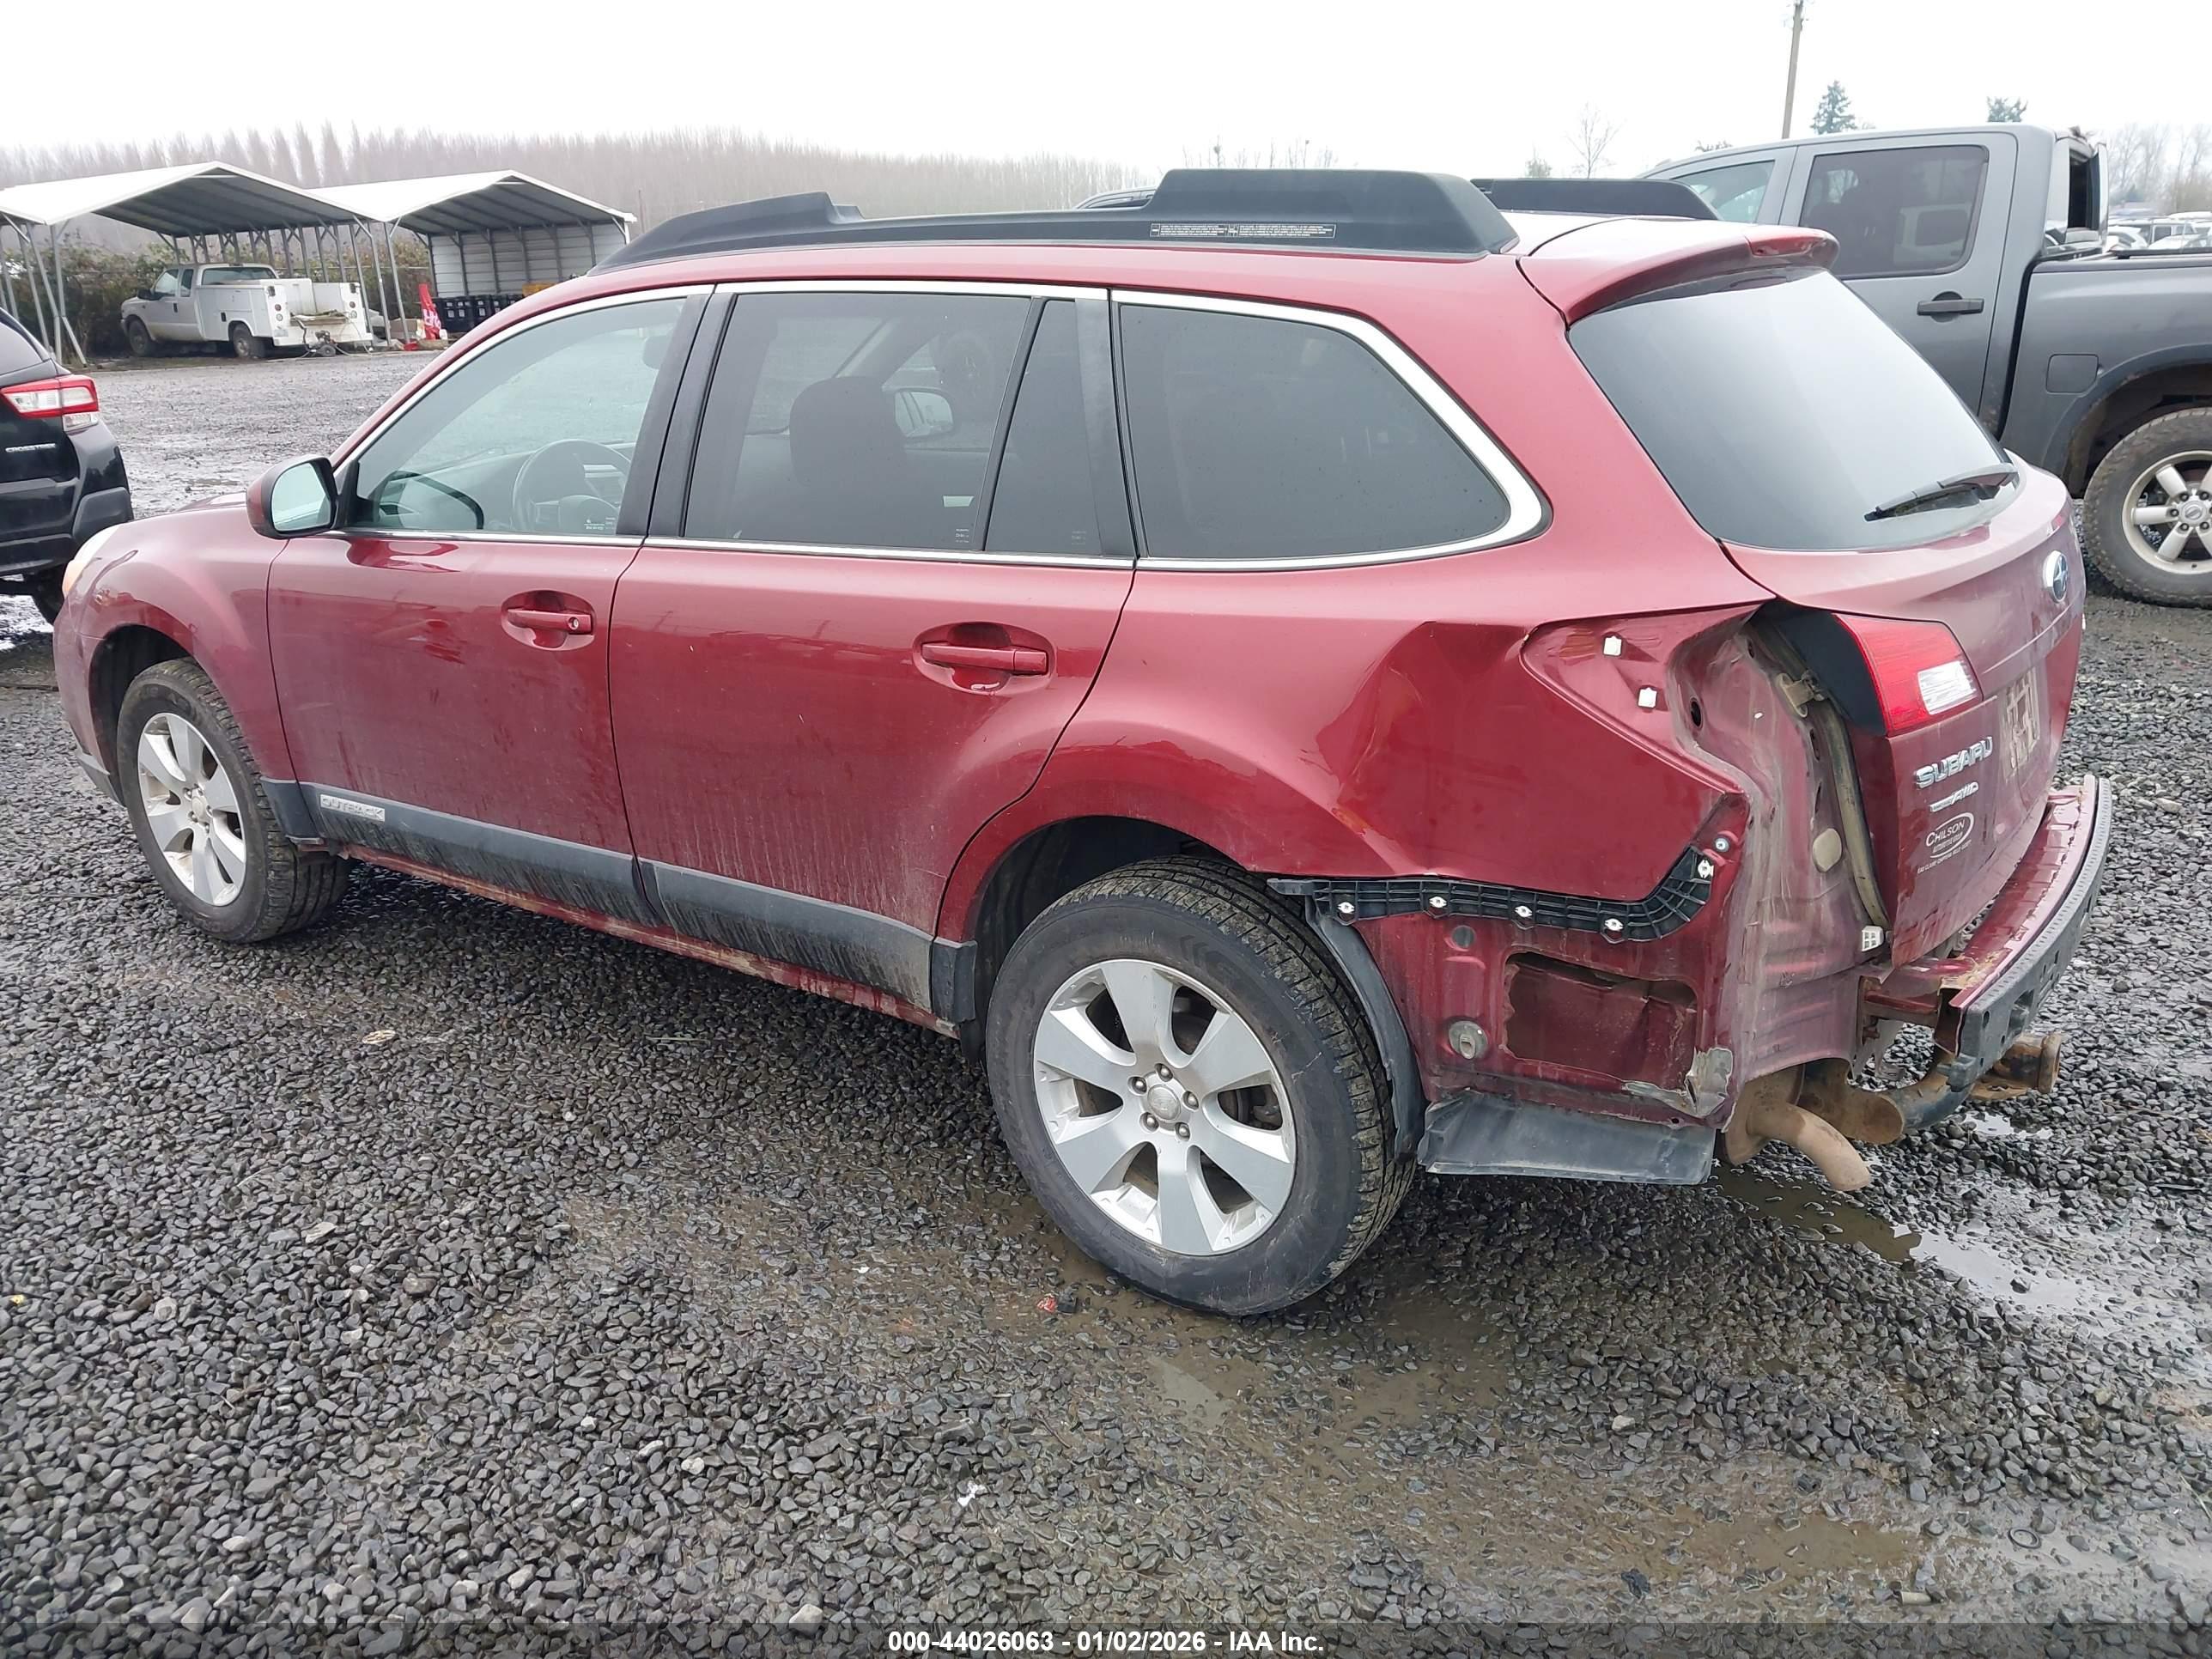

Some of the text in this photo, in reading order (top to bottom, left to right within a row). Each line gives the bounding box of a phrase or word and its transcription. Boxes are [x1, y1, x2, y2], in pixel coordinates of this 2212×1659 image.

[1915, 735, 1993, 789] SUBARU
[322, 795, 385, 821] OUTBACK
[1925, 818, 1966, 848] CHILSON
